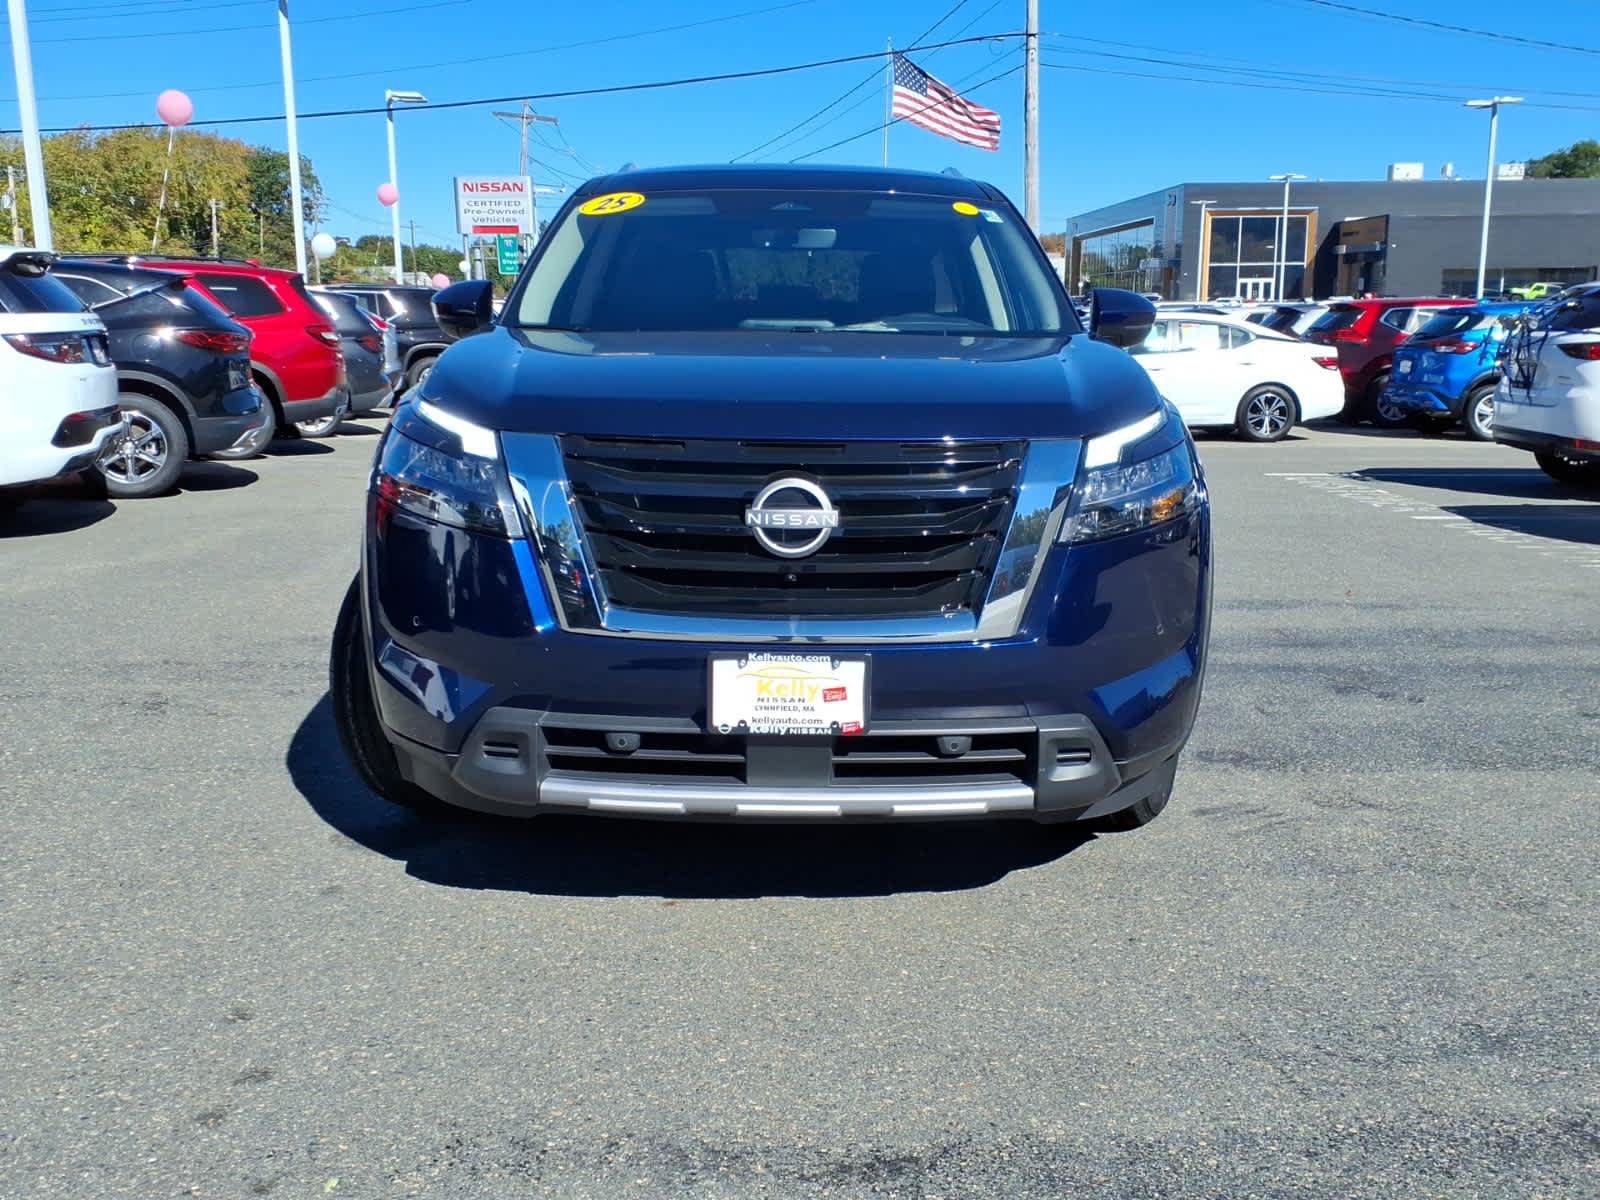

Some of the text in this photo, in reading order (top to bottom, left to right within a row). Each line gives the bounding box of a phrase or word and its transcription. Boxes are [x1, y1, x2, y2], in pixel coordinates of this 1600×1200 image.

[463, 182, 524, 192] NISSAN
[592, 195, 633, 211] 25
[747, 513, 836, 526] NISSAN
[755, 678, 820, 702] Kelly
[755, 705, 799, 713] LYNNFIELD,
[751, 716, 823, 726] kellyauto.com
[750, 725, 788, 736] Kelly
[789, 727, 832, 735] NISSAN
